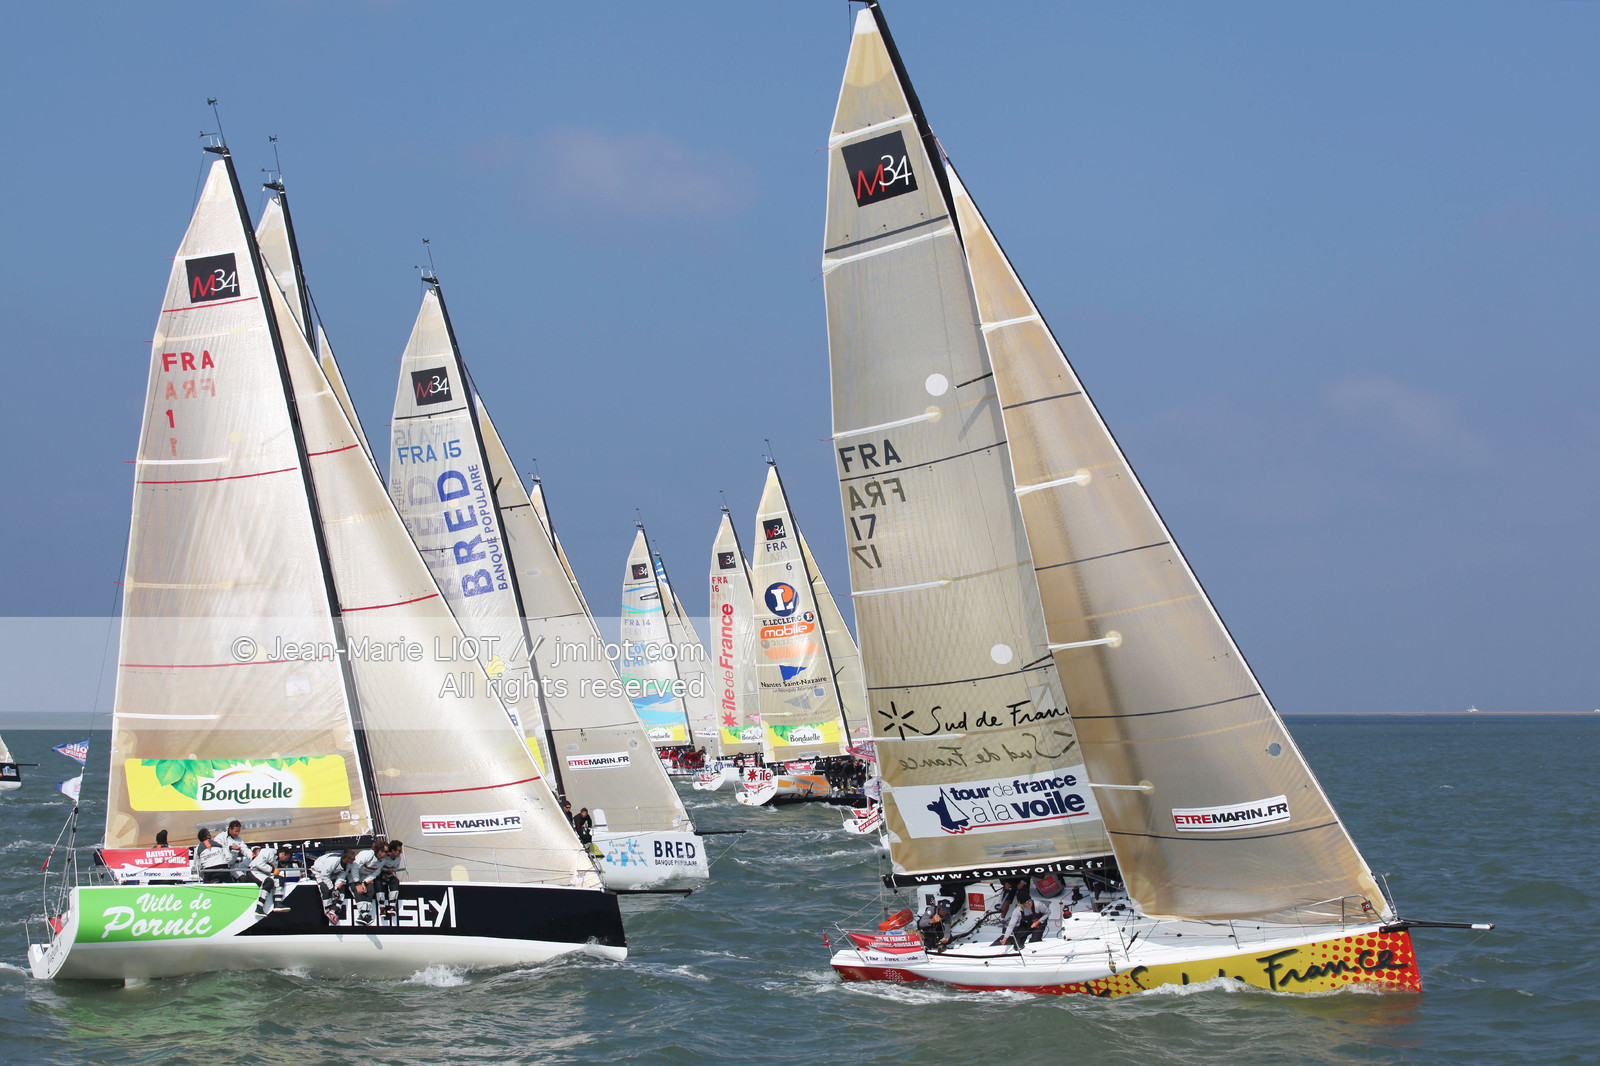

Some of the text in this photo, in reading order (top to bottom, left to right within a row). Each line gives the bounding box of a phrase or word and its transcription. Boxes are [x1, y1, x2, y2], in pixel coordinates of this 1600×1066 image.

[857, 155, 912, 199] M34
[191, 268, 238, 298] M34
[162, 350, 215, 372] FRA
[416, 375, 449, 398] M34
[165, 409, 175, 428] 1
[397, 439, 462, 465] FRA 15
[838, 439, 902, 473] FRA
[437, 470, 494, 598] BRED
[468, 463, 508, 591] BANQUE POPULAIRE
[766, 525, 785, 538] M34
[850, 513, 877, 541] 17
[766, 541, 787, 552] FRA
[785, 562, 792, 571] 6
[712, 576, 728, 584] FRA
[712, 585, 720, 593] 16
[764, 624, 808, 638] mobile
[921, 706, 968, 735] Sud
[976, 711, 1002, 727] de
[789, 733, 820, 743] Bonduelle
[568, 756, 629, 767] ETREMARIN.FR
[200, 782, 293, 804] Bonduelle
[950, 774, 1077, 801] tour de france
[972, 793, 1085, 823] à la voile
[1174, 802, 1288, 824] ETREMARIN.FR
[422, 816, 521, 829] ETREMARIN.FR
[145, 850, 176, 858] BATISTYL
[654, 840, 695, 859] BRED
[915, 860, 1103, 883] www.tourvoile.fr
[136, 893, 212, 912] Ville de
[101, 906, 212, 939] Pornic
[1256, 948, 1410, 991] France
